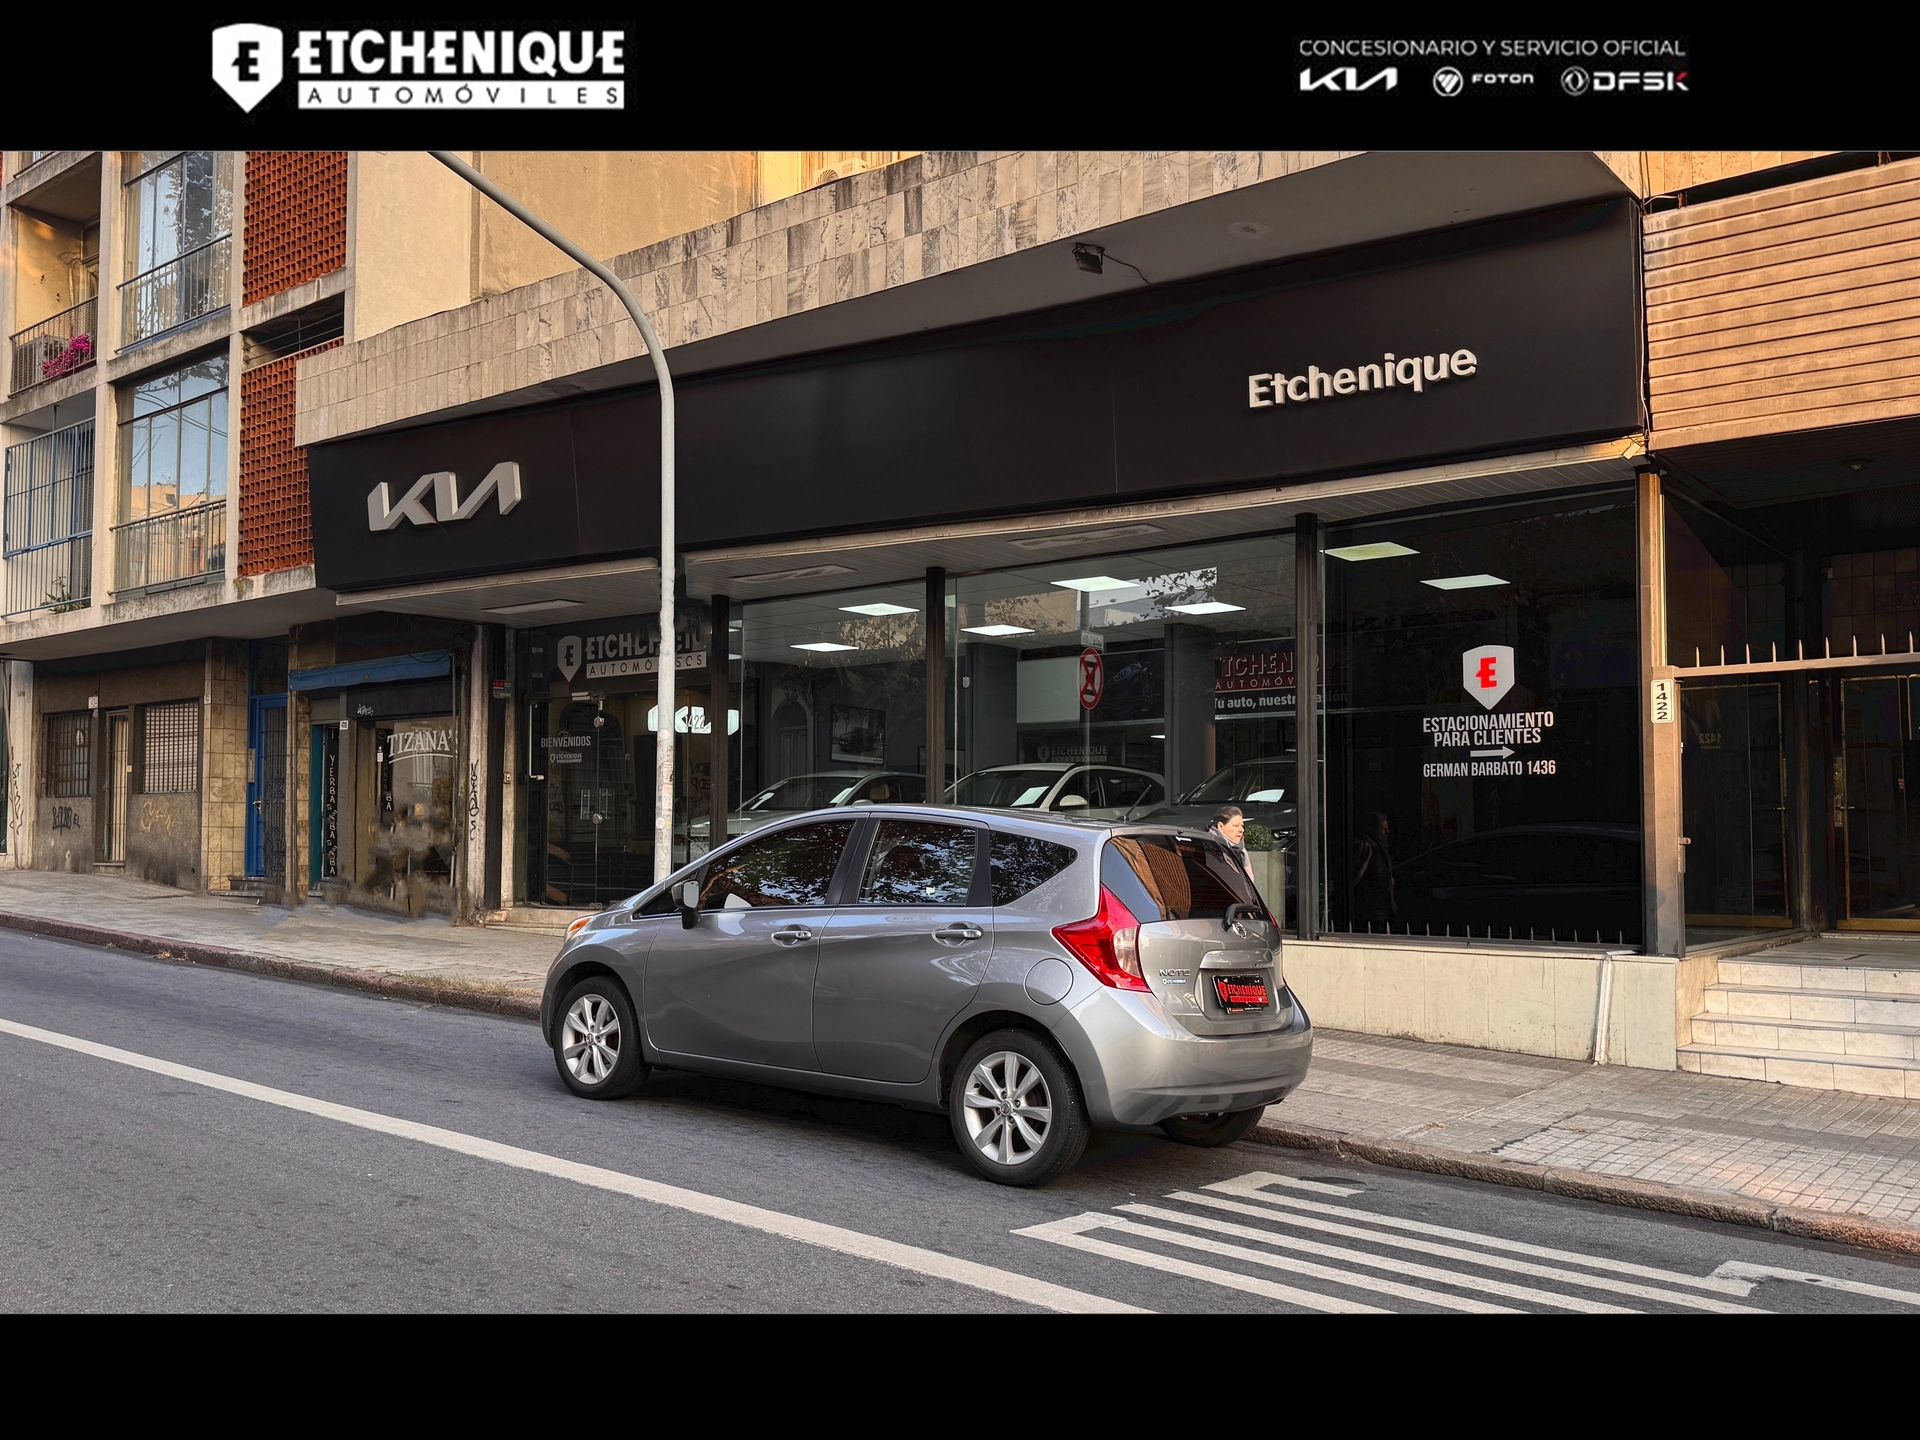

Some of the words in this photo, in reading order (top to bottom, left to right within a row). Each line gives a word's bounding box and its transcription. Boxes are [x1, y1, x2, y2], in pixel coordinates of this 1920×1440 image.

[1248, 348, 1478, 408] Etchenique
[367, 461, 522, 532] KIA
[1227, 695, 1257, 710] auto,
[1258, 693, 1297, 708] nuestr
[1655, 682, 1668, 720] 1422
[1423, 710, 1555, 733] ESTACIONAMIENTO
[540, 735, 592, 748] BIENVENIDOS
[1433, 731, 1471, 748] PARA
[1474, 727, 1542, 746] CLIENTES
[1423, 761, 1469, 778] GERMAN
[1471, 760, 1523, 777] BARBATO
[1526, 759, 1557, 776] 1436
[1159, 968, 1191, 977] NOTE
